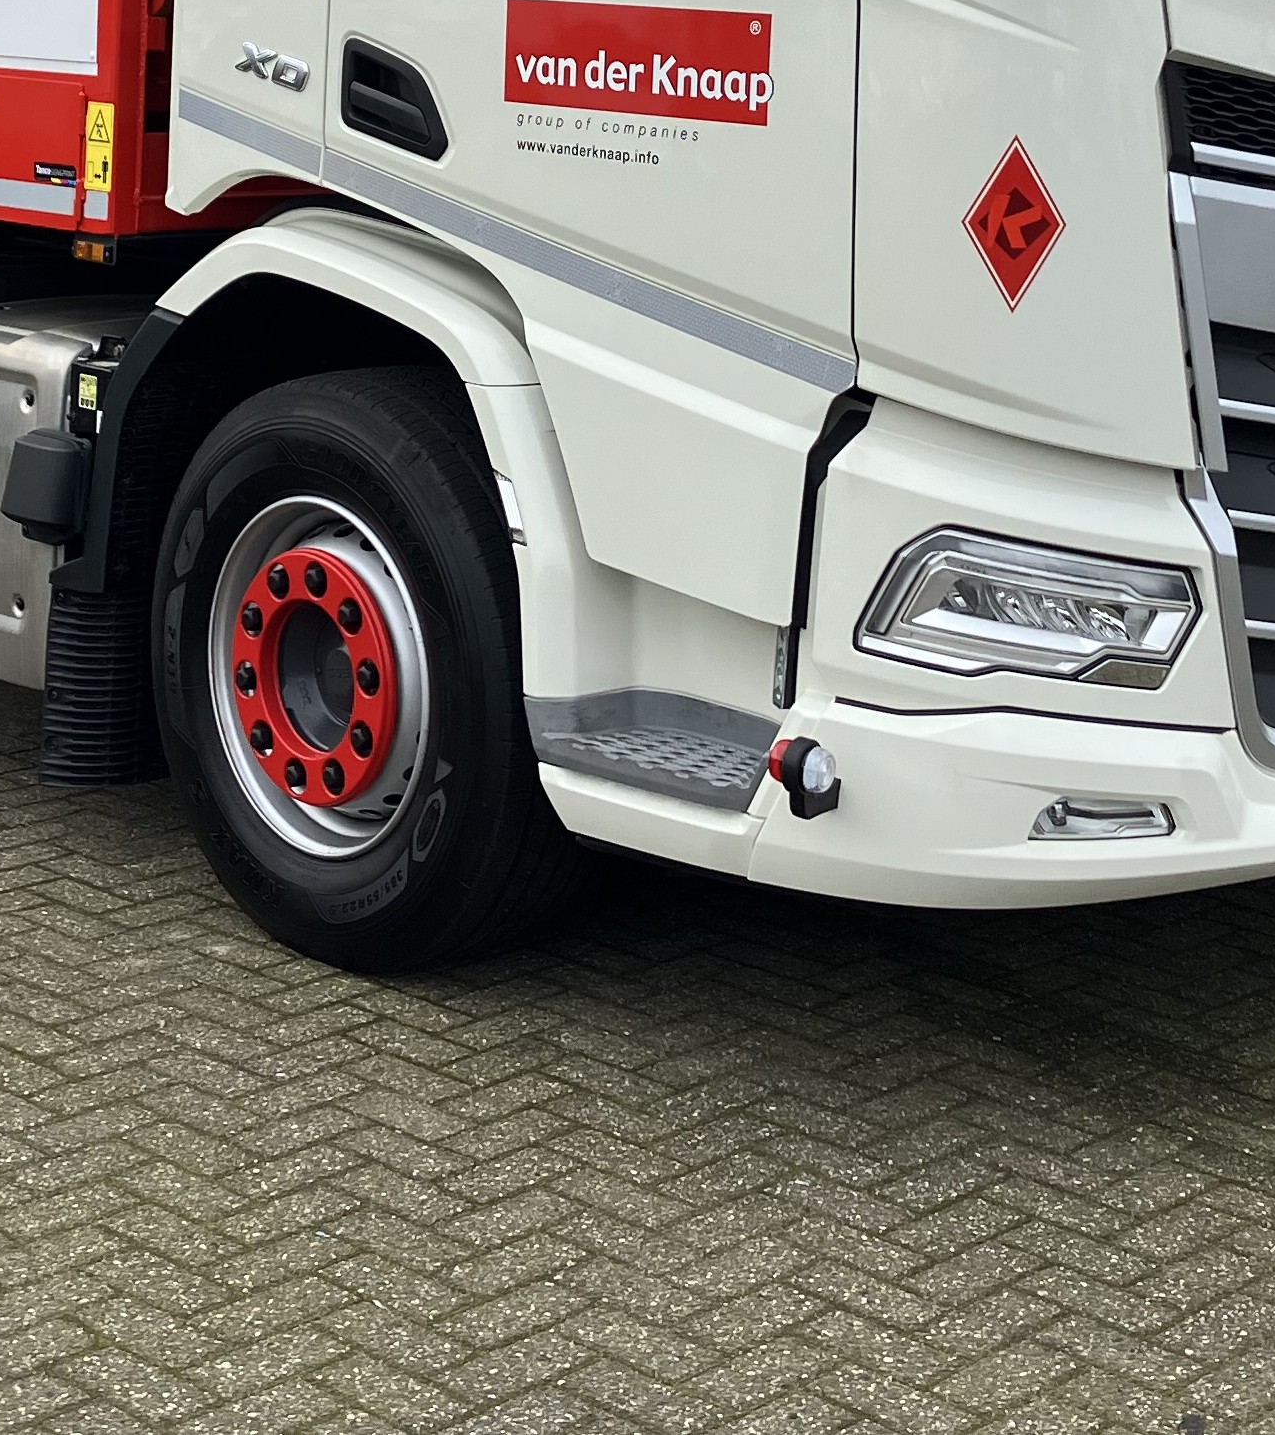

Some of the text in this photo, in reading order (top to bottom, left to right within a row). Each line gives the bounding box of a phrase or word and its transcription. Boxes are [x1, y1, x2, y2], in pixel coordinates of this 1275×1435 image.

[235, 42, 311, 92] XD
[515, 50, 774, 111] van der Knaap
[517, 113, 700, 142] group of companies
[517, 139, 660, 165] www.vanderknaap.info
